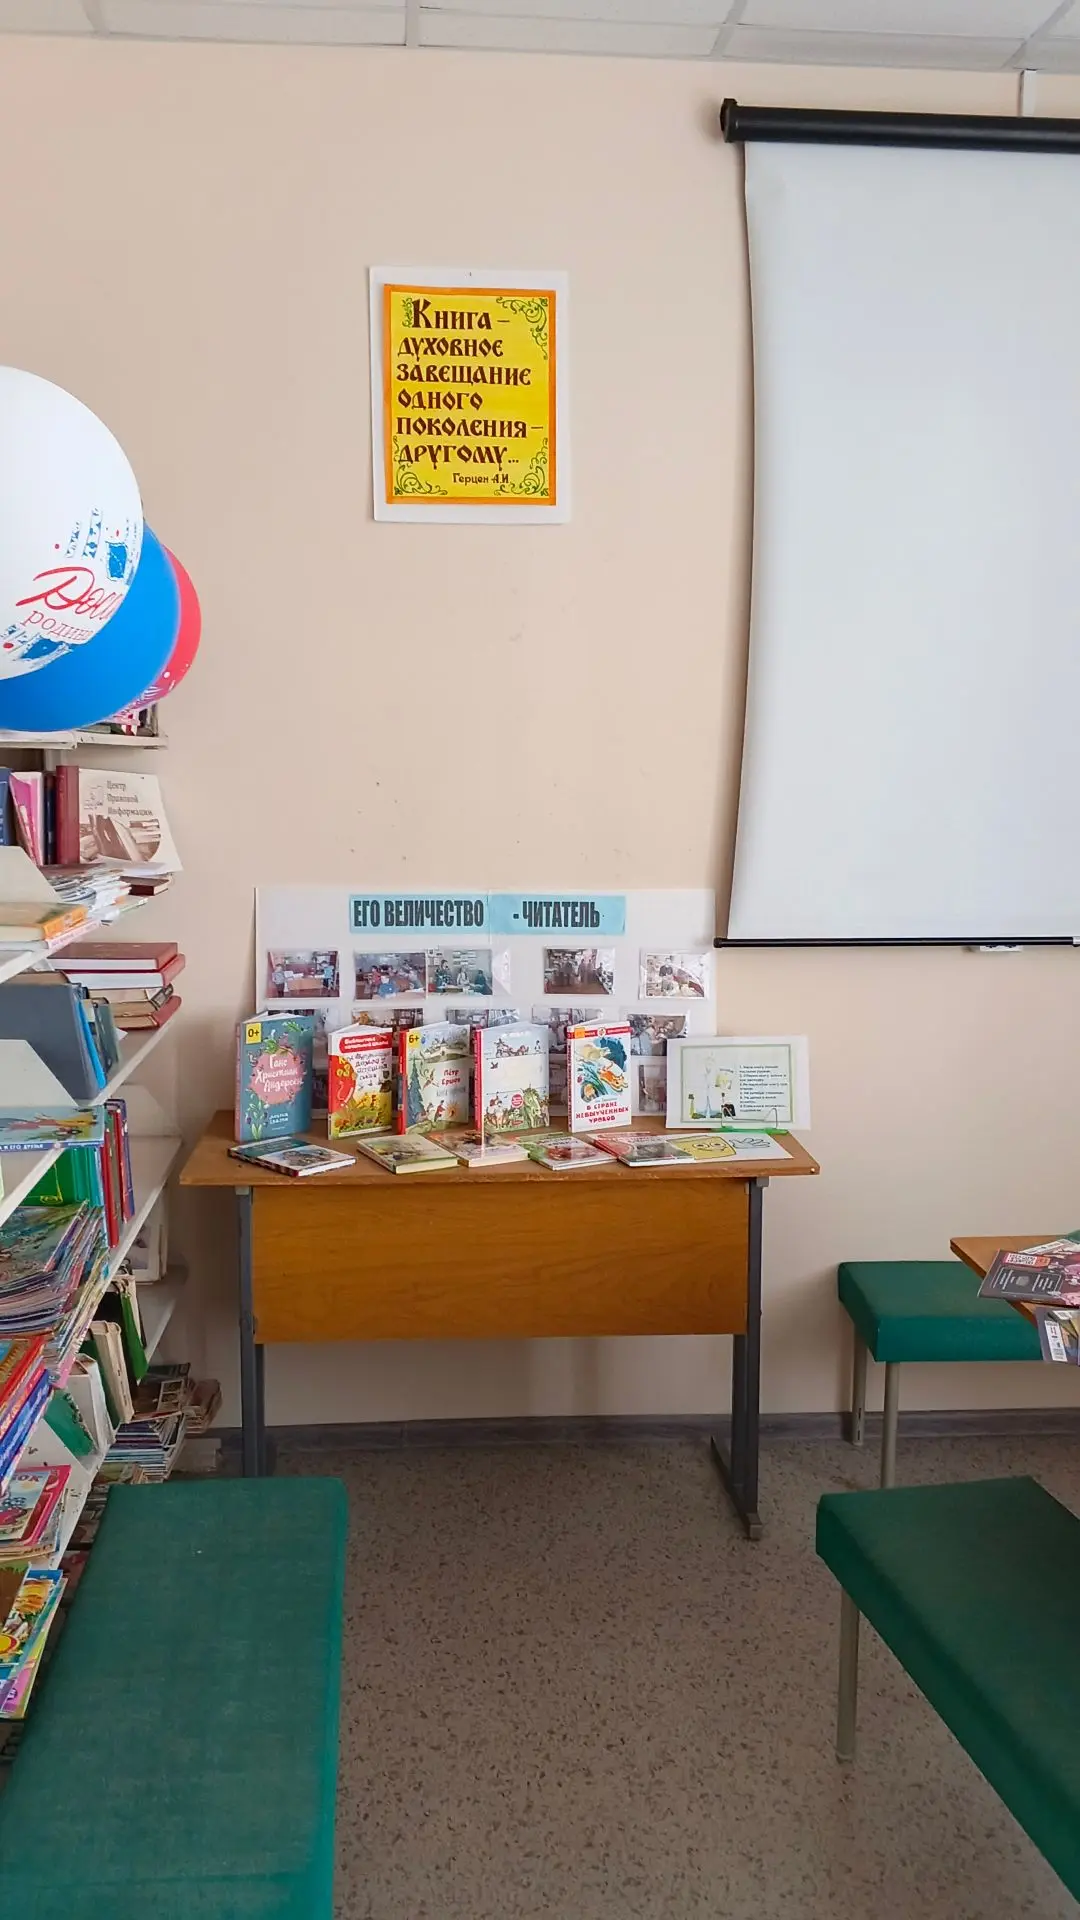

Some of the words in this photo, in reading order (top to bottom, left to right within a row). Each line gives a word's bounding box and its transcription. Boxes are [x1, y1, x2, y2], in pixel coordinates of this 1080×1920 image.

[452, 472, 489, 486] Герцен
[353, 899, 380, 927] ЕГО
[384, 899, 484, 928] ВЕЛИЧЕСТВО
[248, 1028, 260, 1038] 0+
[408, 1034, 420, 1044] 6+
[269, 1054, 288, 1069] Ганс
[254, 1068, 298, 1085] Христиан
[263, 1077, 304, 1093] Андерсен
